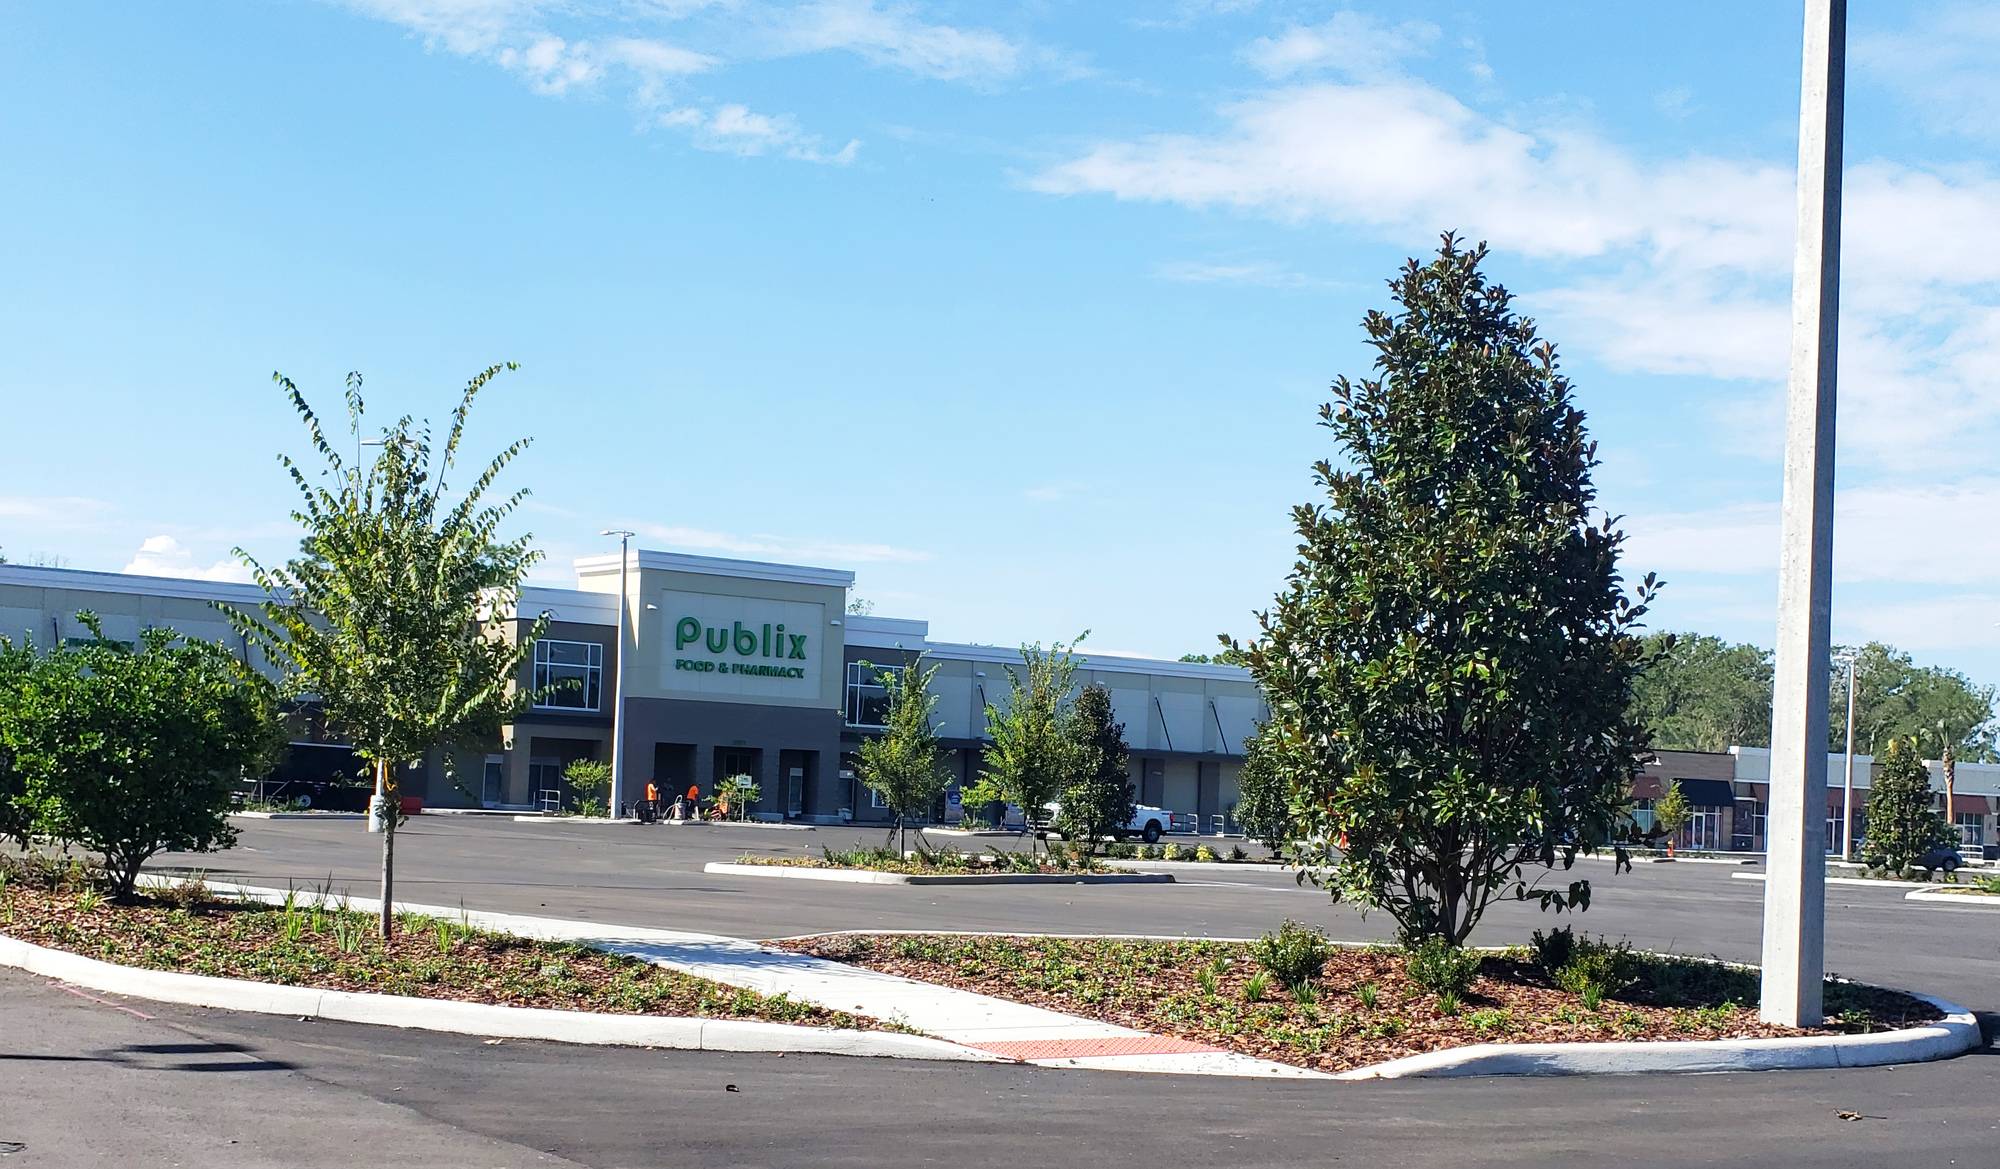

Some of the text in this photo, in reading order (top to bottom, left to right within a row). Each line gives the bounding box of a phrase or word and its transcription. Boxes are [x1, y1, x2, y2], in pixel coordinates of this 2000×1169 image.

[676, 616, 807, 660] Publix
[675, 659, 805, 679] FOOD & PHARMACY
